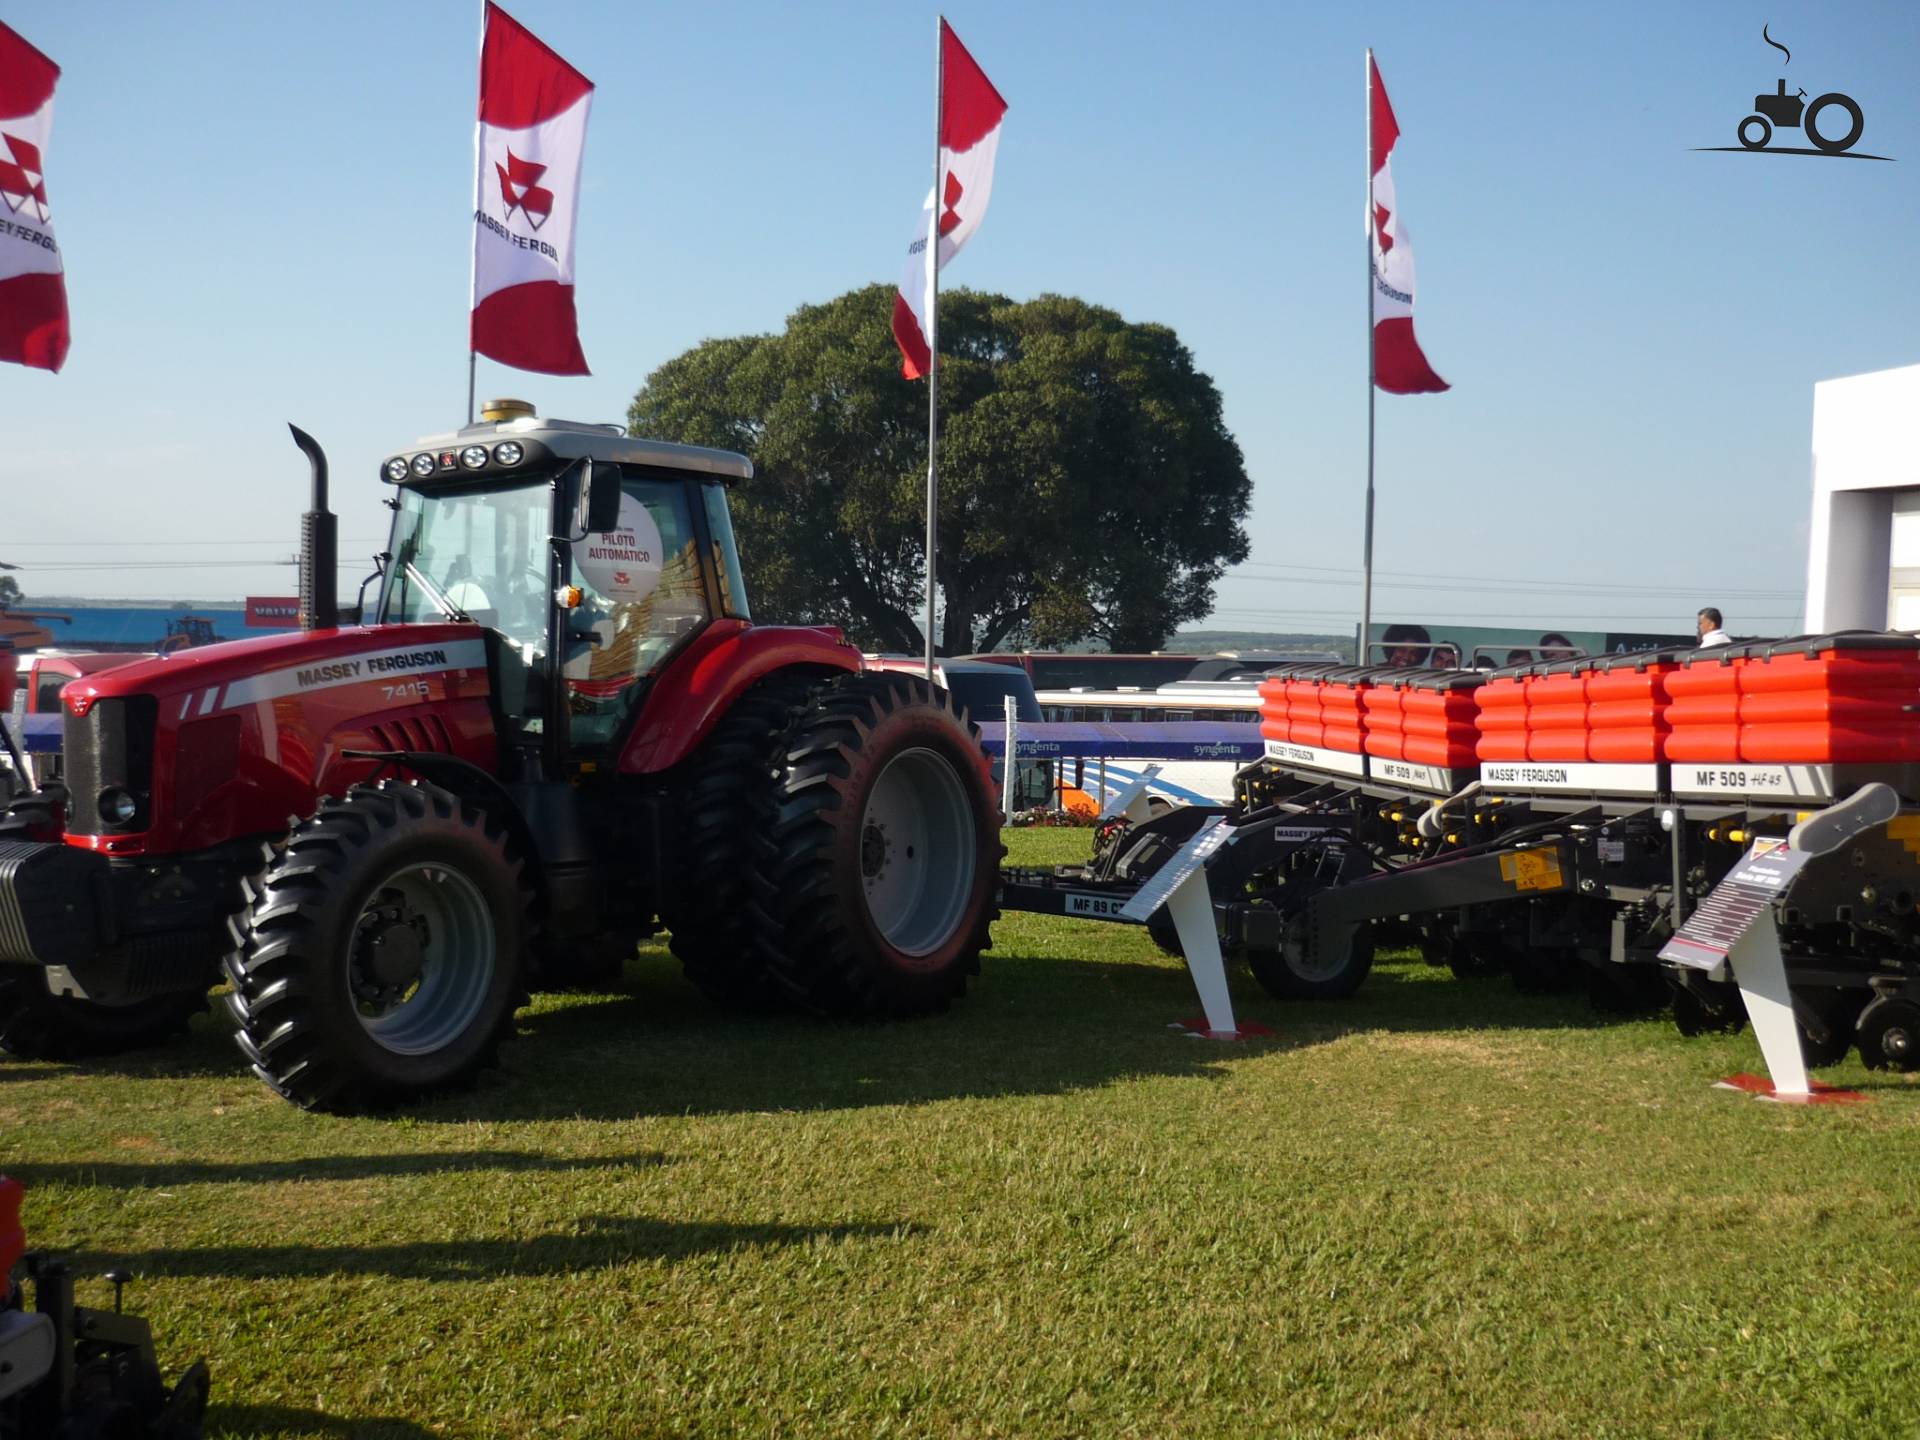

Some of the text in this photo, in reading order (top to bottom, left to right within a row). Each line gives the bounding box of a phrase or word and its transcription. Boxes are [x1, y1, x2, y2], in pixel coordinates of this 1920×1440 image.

[297, 650, 448, 688] MASSEY FERGUSON
[381, 680, 430, 700] 7415
[1015, 740, 1060, 754] yngenta
[1193, 741, 1241, 756] syngenta
[1268, 743, 1315, 761] MASSEY FERGUSON
[1384, 763, 1395, 776] MF
[1396, 765, 1411, 779] 509
[1487, 767, 1567, 783] MASSEY FERGUSON
[1696, 771, 1715, 786] MF
[1720, 771, 1747, 787] 509
[1073, 898, 1090, 911] MF
[1093, 900, 1108, 913] 89
